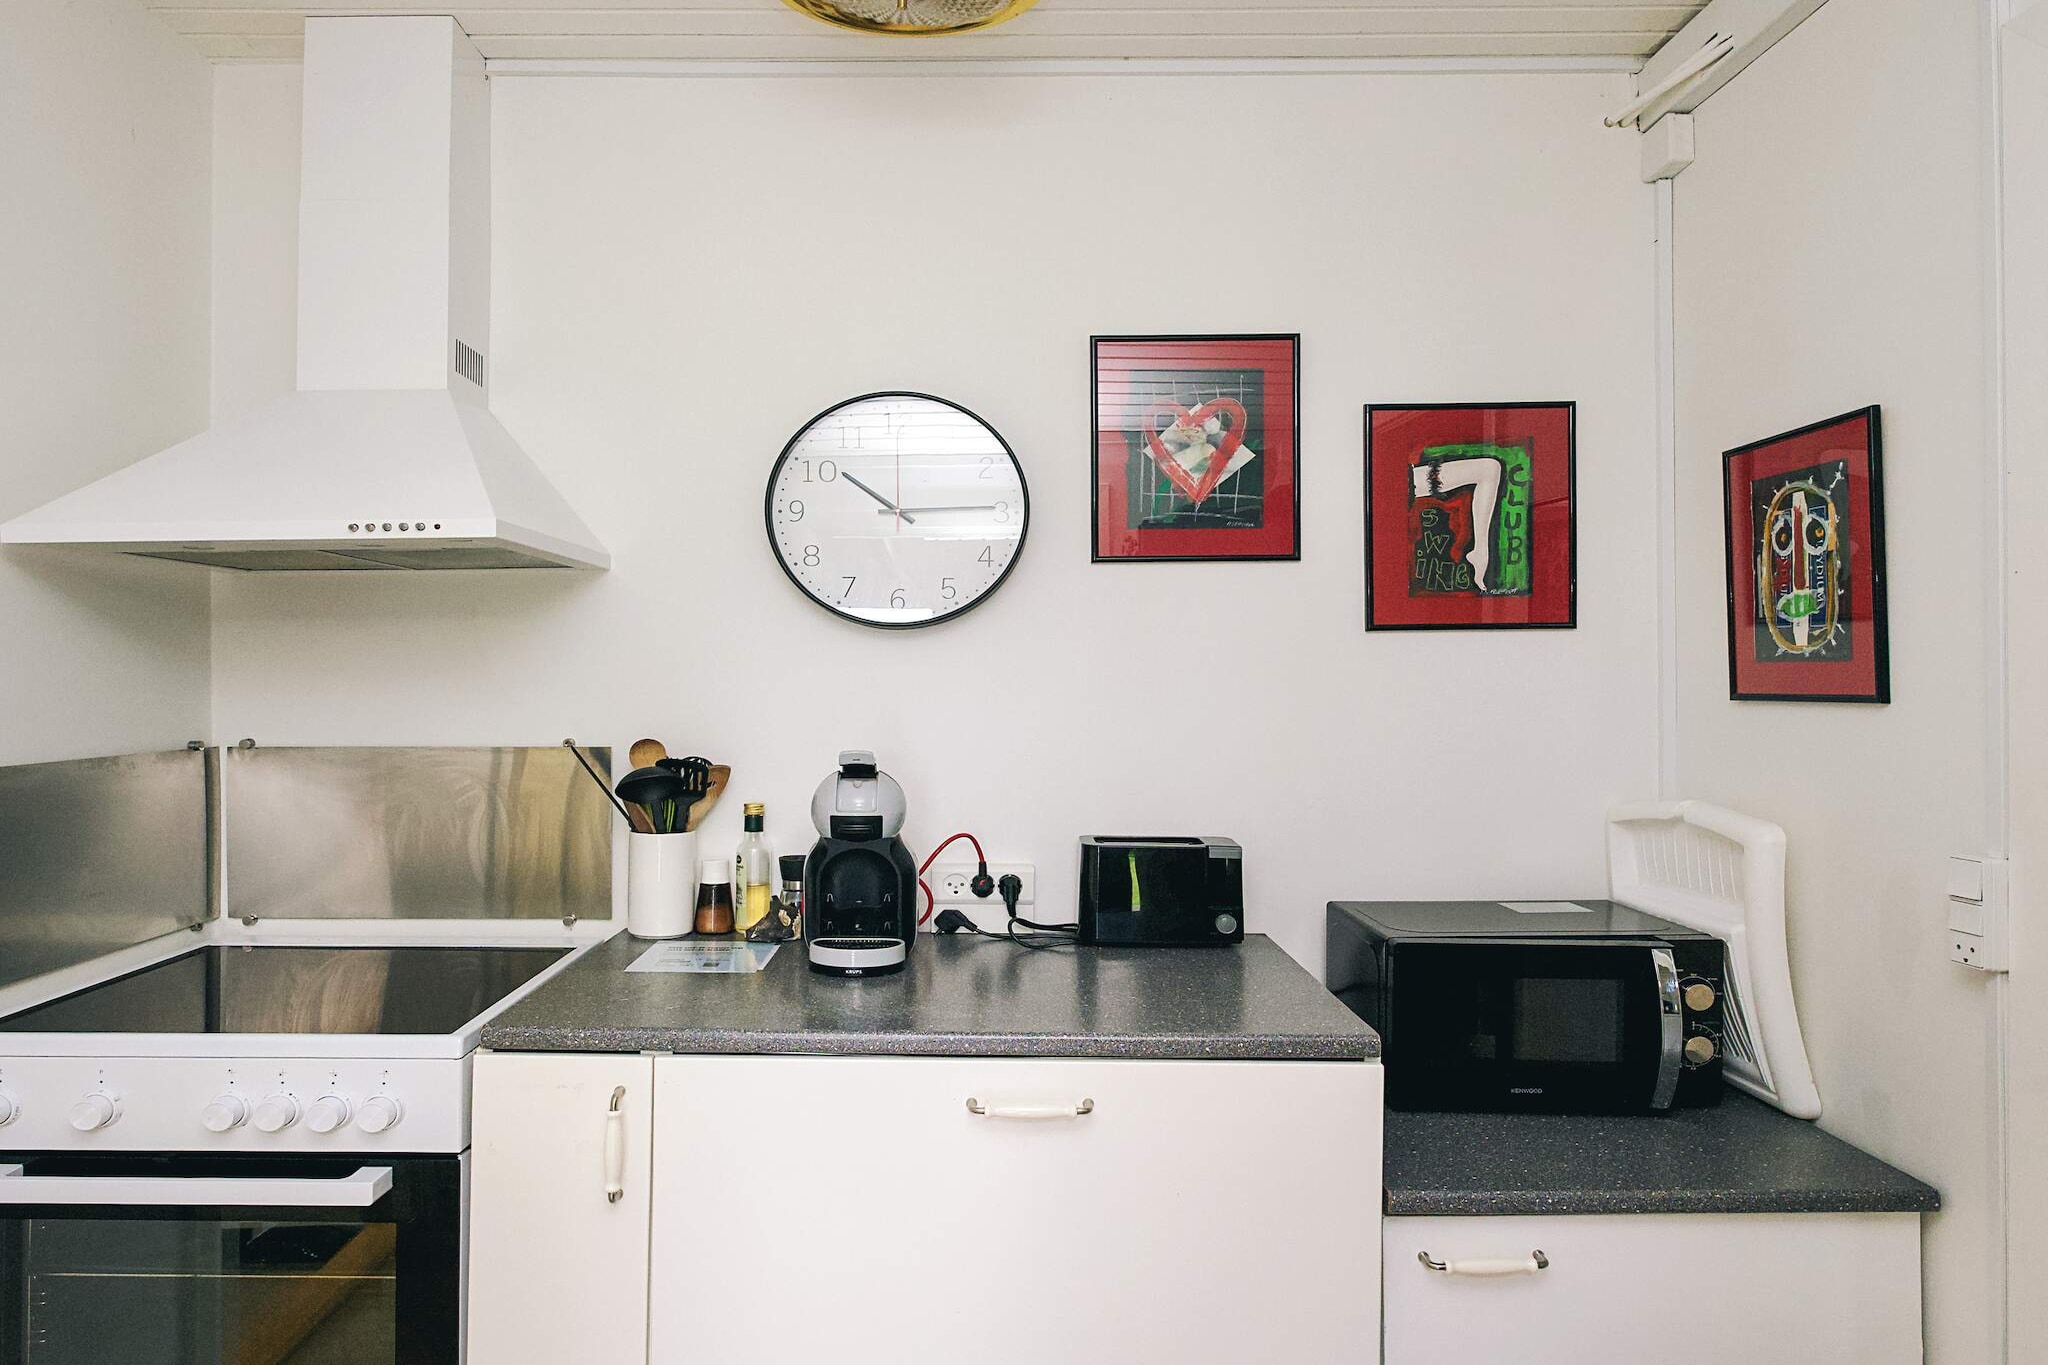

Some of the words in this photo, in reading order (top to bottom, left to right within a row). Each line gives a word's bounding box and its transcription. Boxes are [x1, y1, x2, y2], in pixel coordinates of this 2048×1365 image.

[801, 459, 837, 483] 10
[978, 456, 994, 479] 2
[788, 499, 805, 523] 9
[993, 501, 1010, 523] 3
[1504, 463, 1528, 565] CLUB
[802, 544, 821, 567] 8
[976, 545, 995, 567] 4
[841, 575, 857, 598] 7
[941, 577, 957, 599] 5
[890, 587, 906, 610] 6
